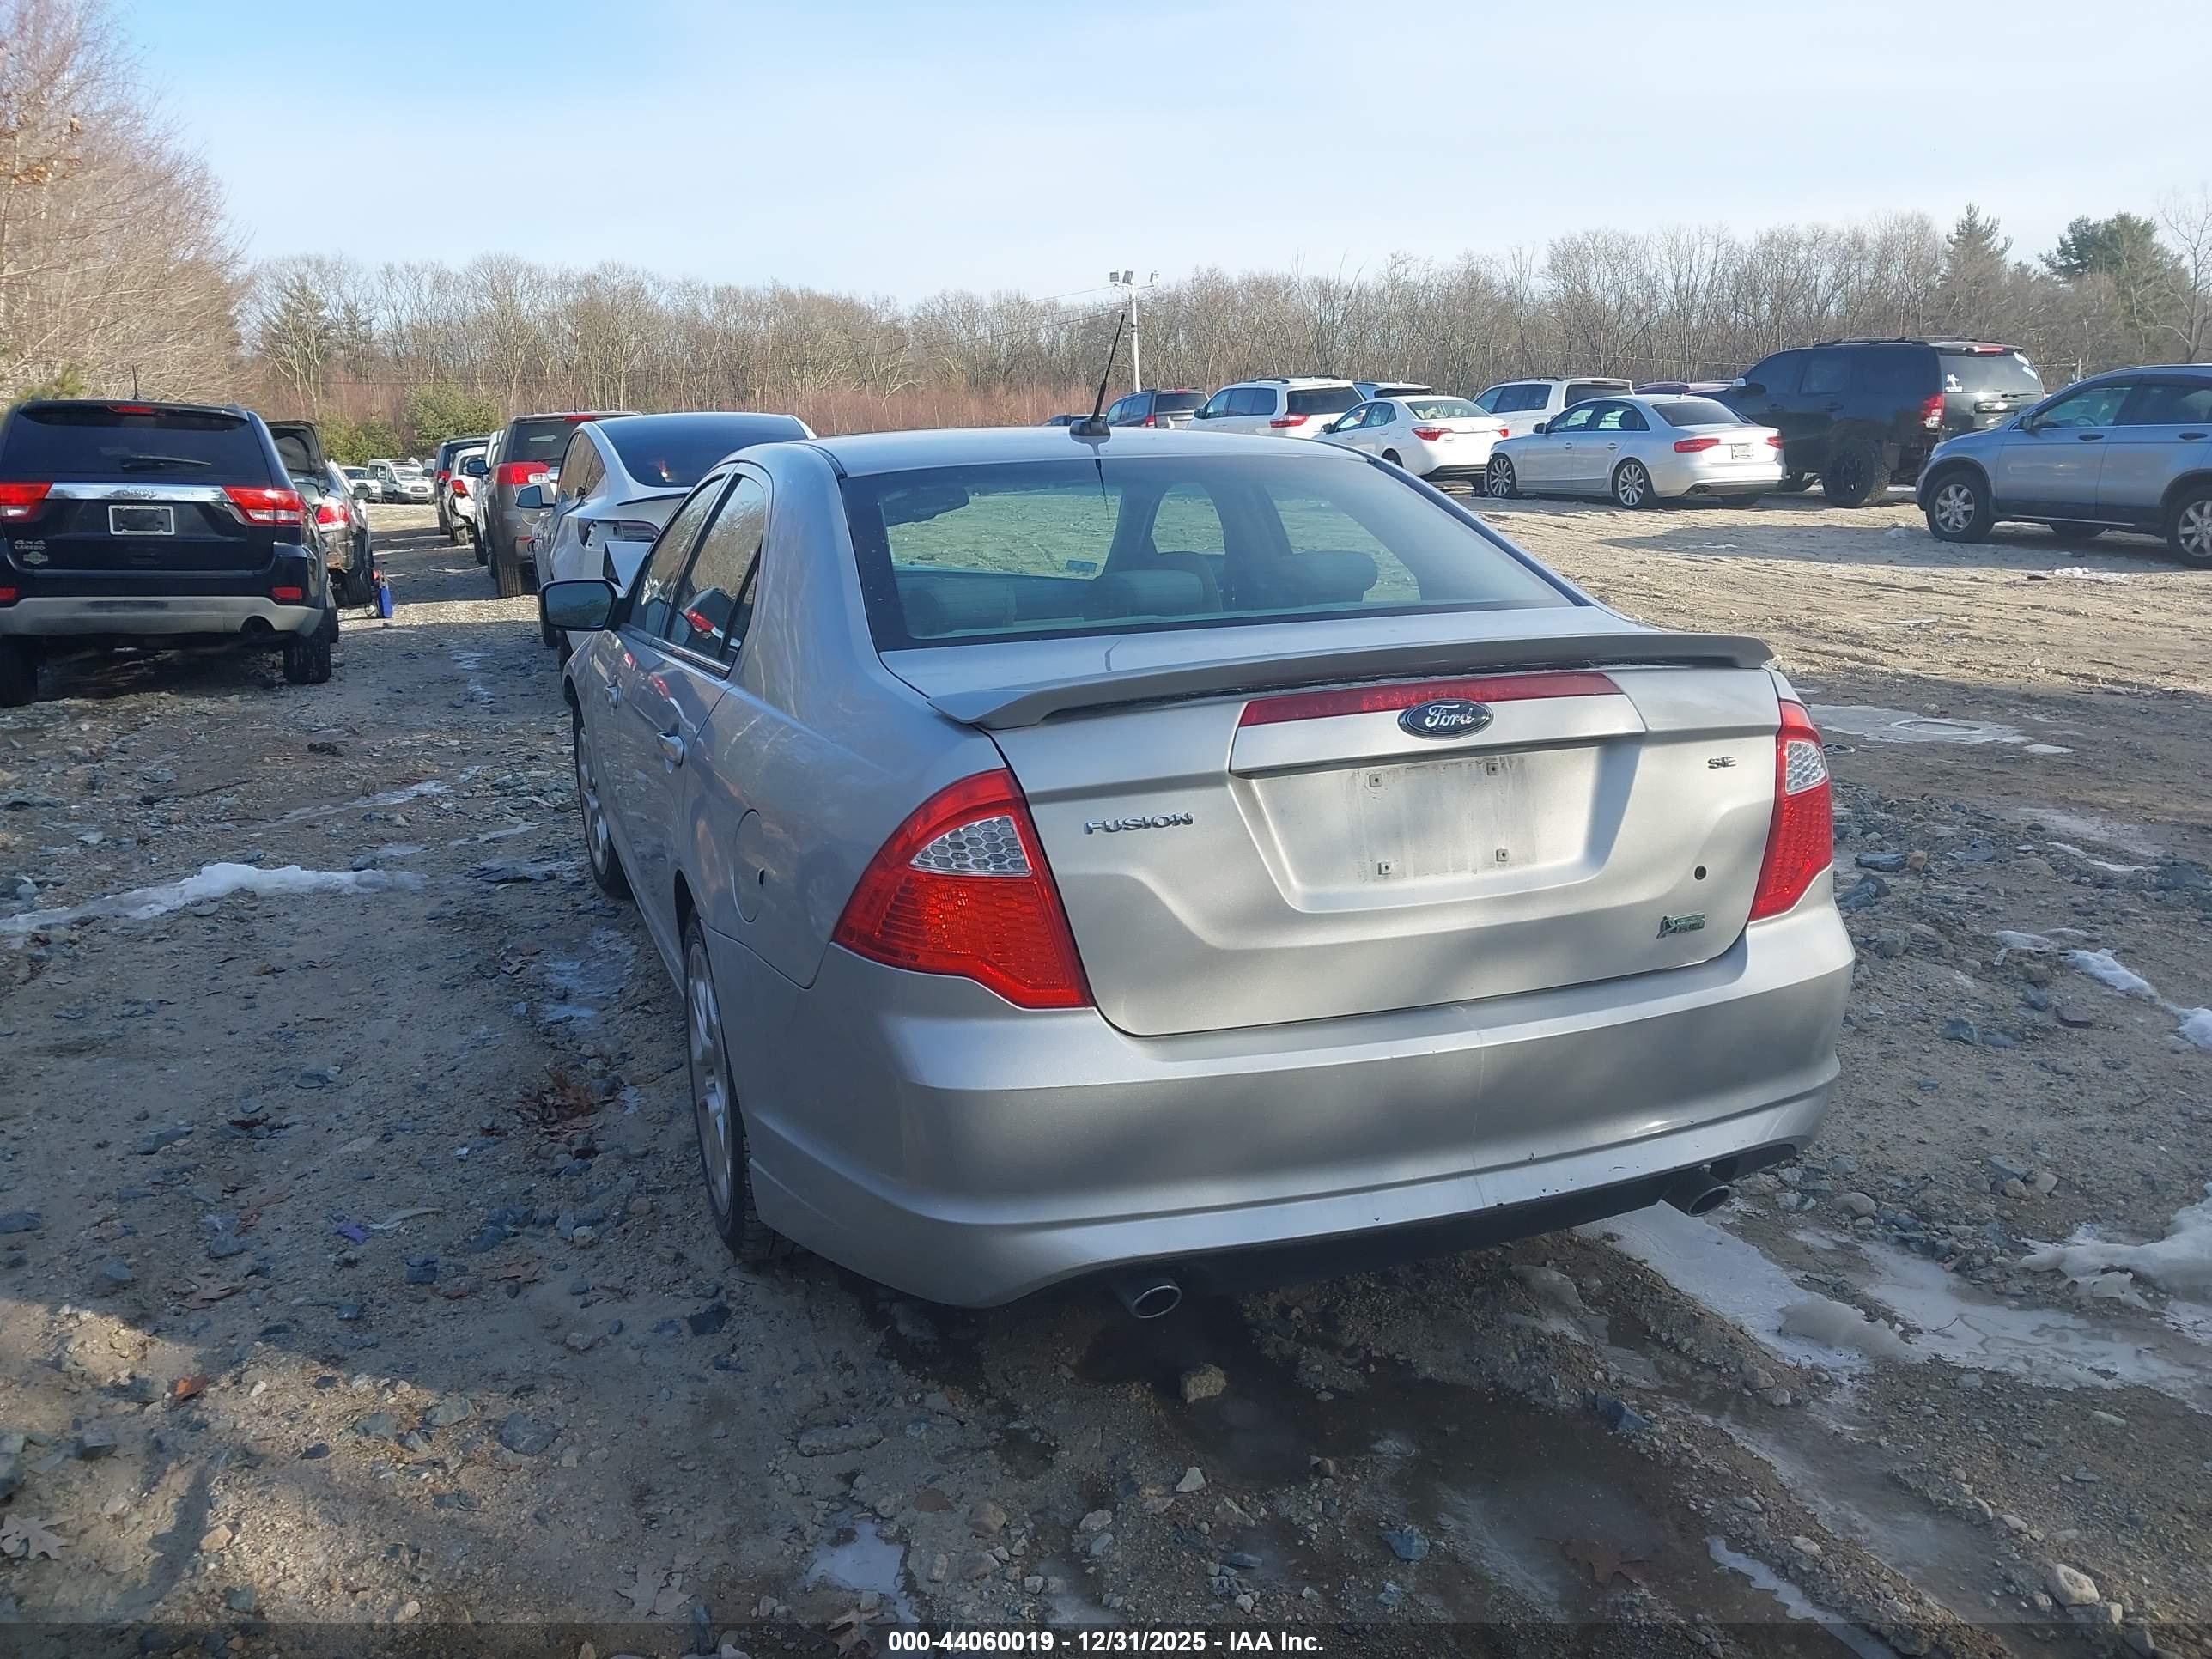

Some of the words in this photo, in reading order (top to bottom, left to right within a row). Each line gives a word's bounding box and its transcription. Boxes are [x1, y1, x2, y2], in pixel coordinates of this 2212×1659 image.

[1425, 704, 1475, 728] Ford
[1707, 756, 1736, 769] SE
[1083, 812, 1194, 835] FUSION
